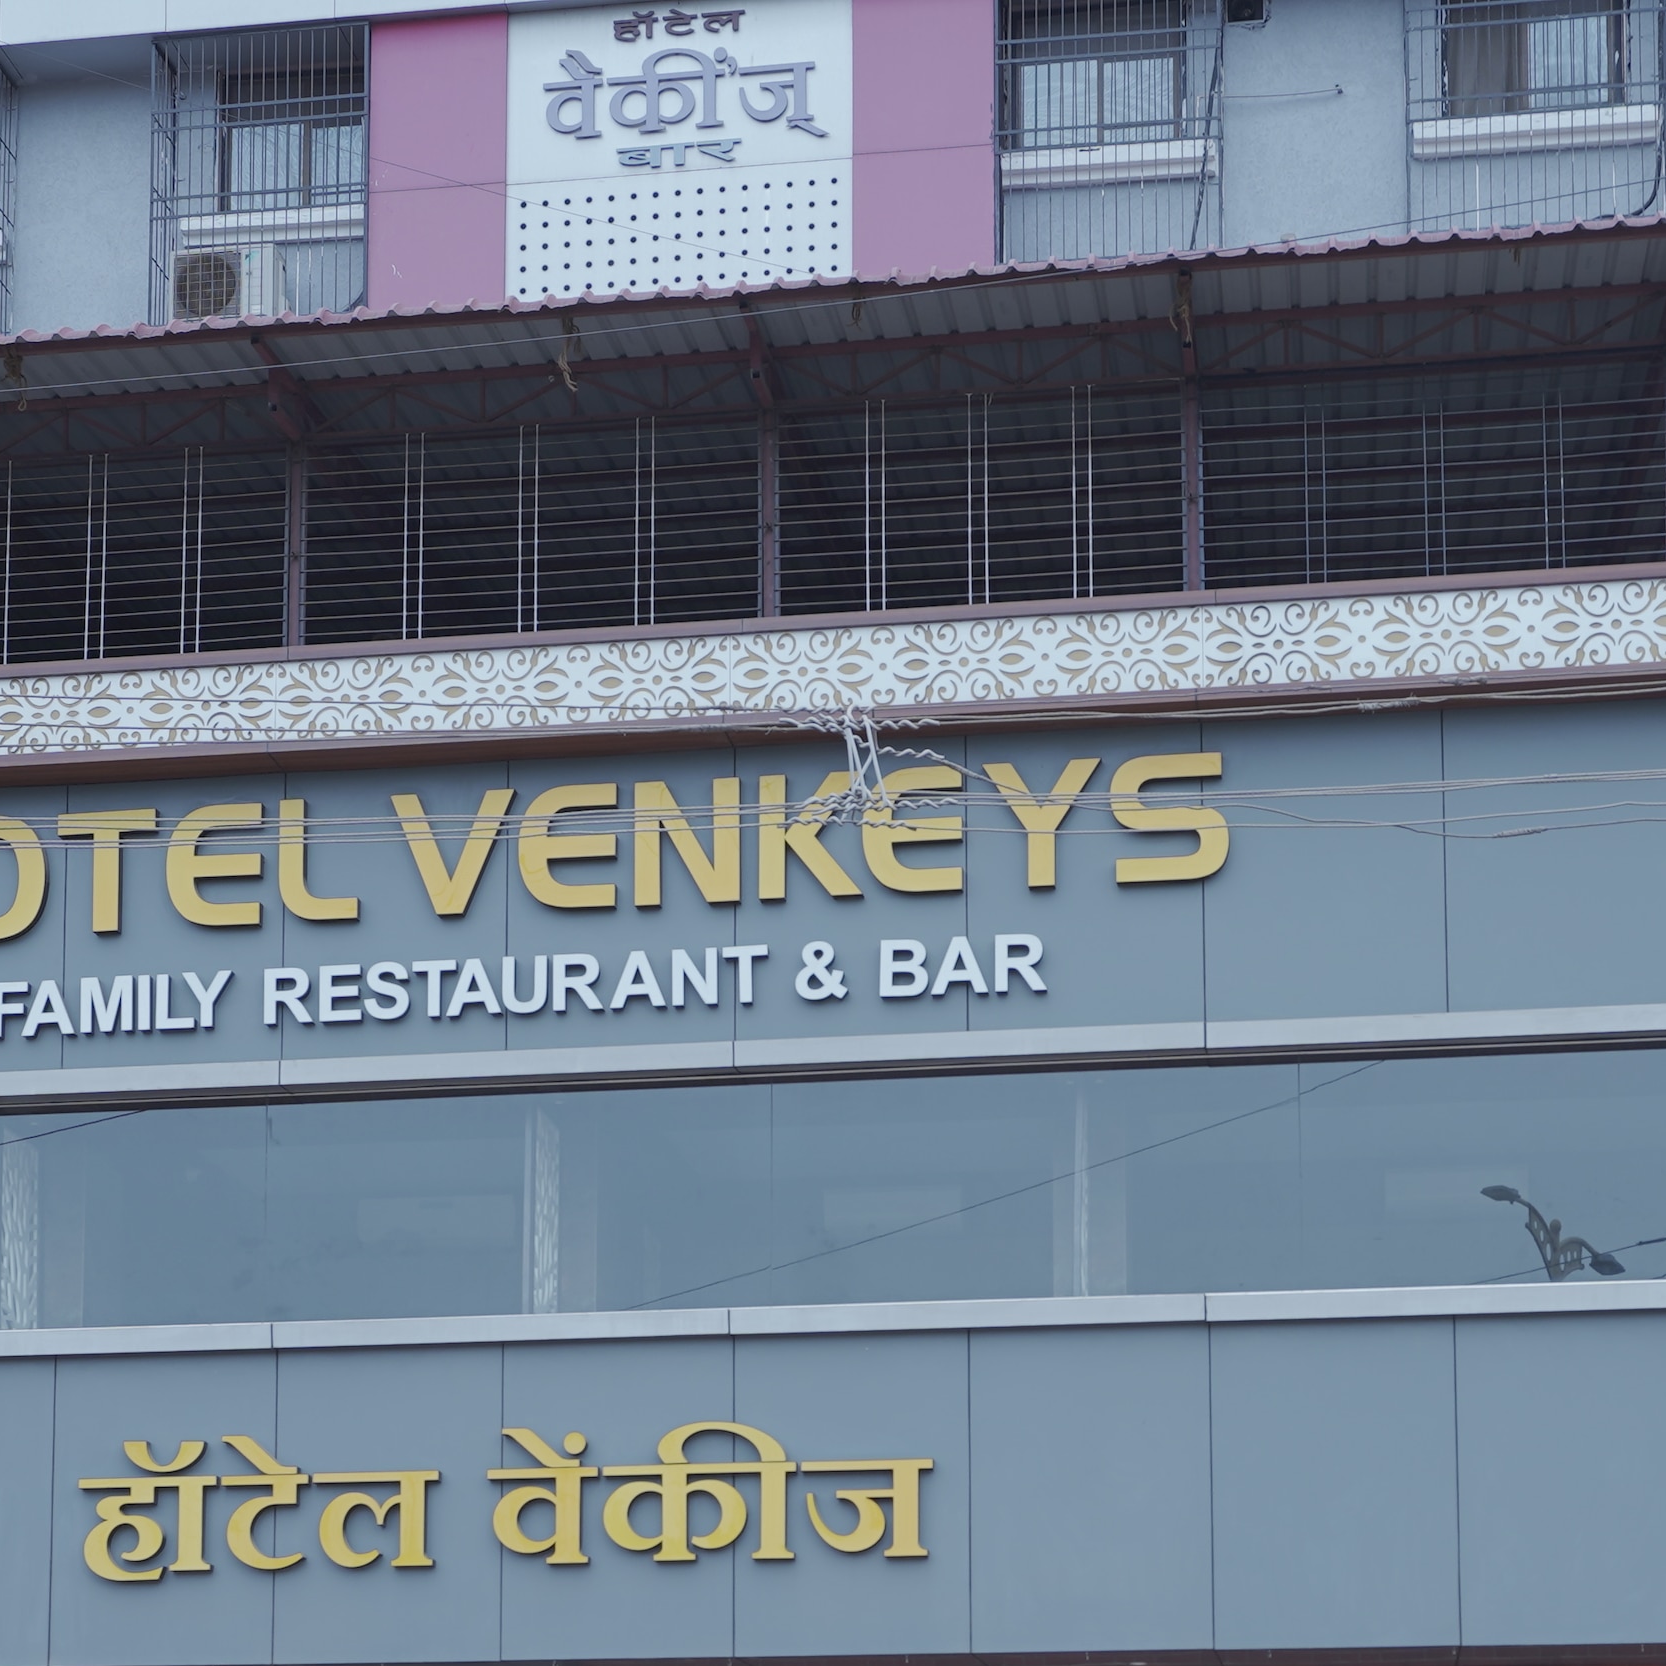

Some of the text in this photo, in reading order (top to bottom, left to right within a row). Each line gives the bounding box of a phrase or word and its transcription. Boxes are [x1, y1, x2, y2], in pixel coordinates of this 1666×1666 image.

[613, 9, 746, 42] हॉटेल
[616, 138, 743, 168] बार
[392, 750, 1231, 917] VENKEYS
[262, 942, 770, 1028] RESTAURANT
[794, 940, 849, 1001] &
[876, 932, 1049, 999] BAR
[77, 1420, 936, 1583] हॉटेल वेंकीज
